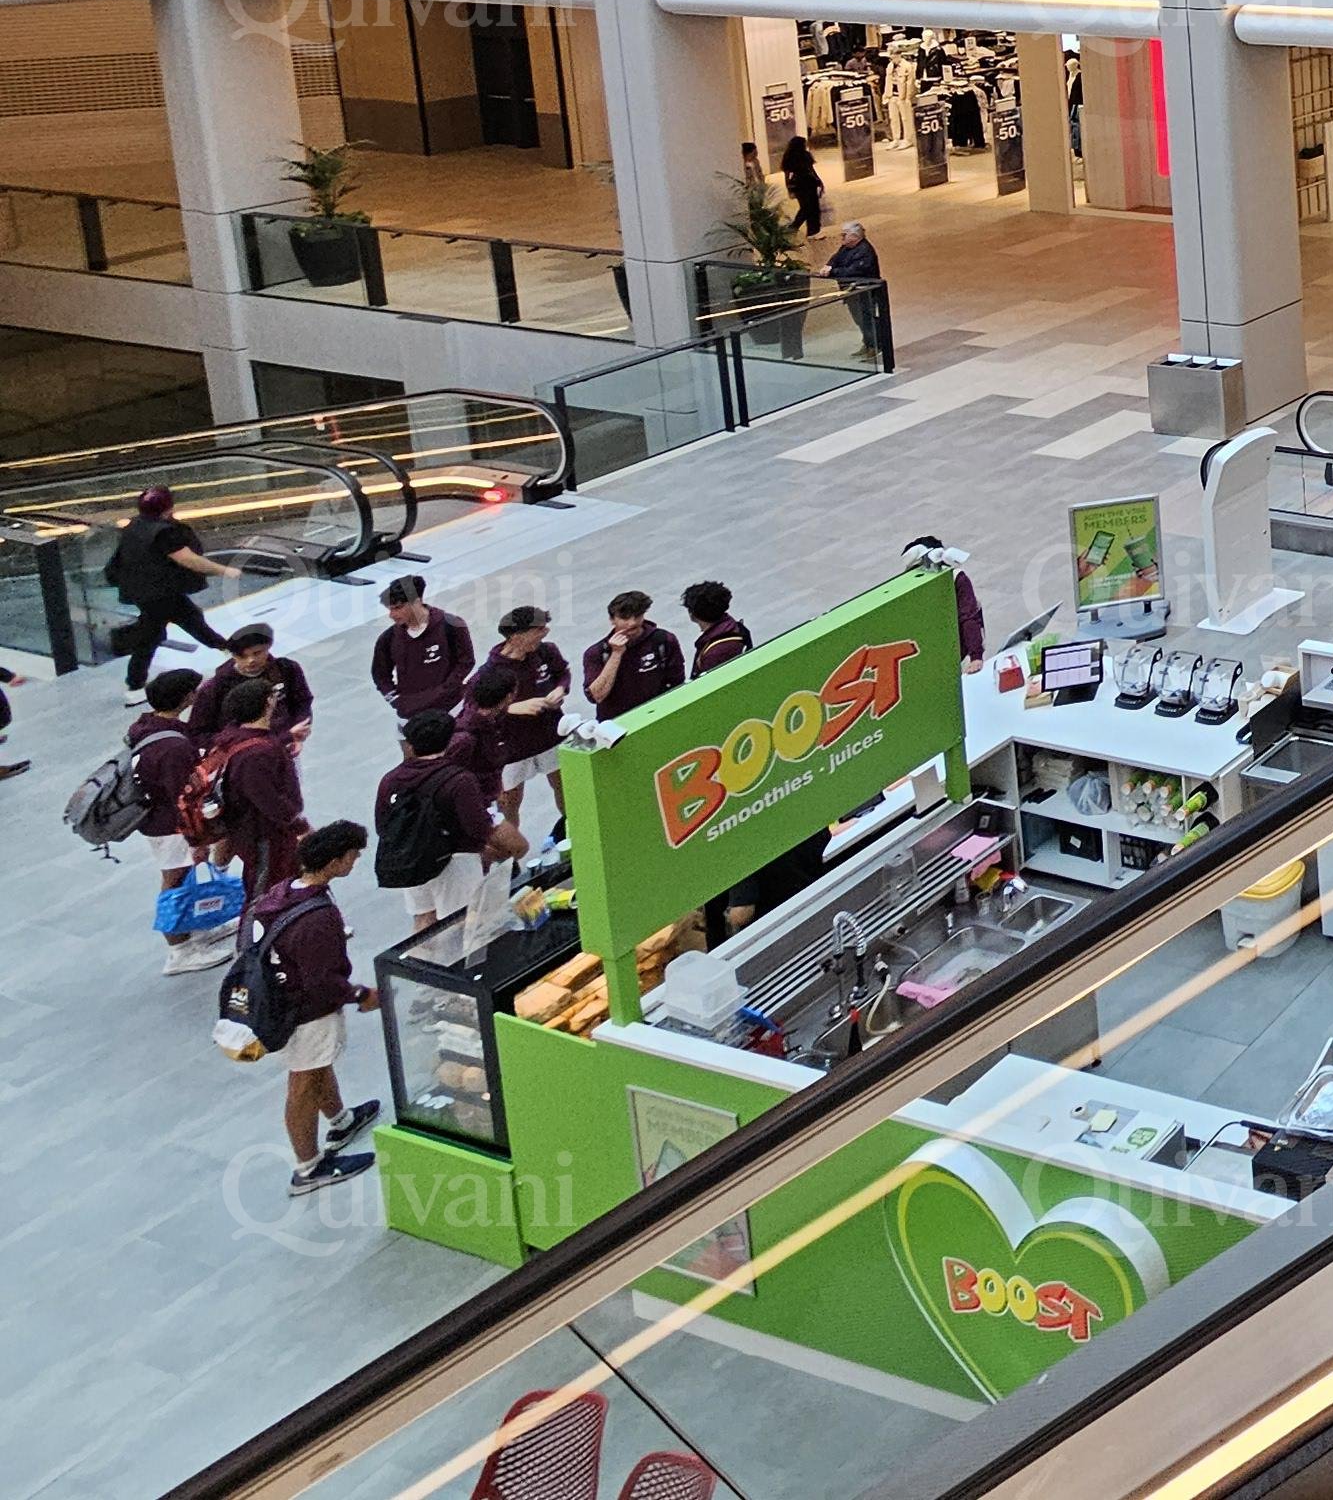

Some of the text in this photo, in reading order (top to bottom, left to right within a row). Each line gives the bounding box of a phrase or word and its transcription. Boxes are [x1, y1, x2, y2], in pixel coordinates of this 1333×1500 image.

[1083, 515, 1148, 531] MEMBERS
[654, 639, 920, 849] BOOST
[706, 767, 814, 842] smoothies
[828, 728, 884, 774] juices
[942, 1256, 1104, 1343] BOOST
